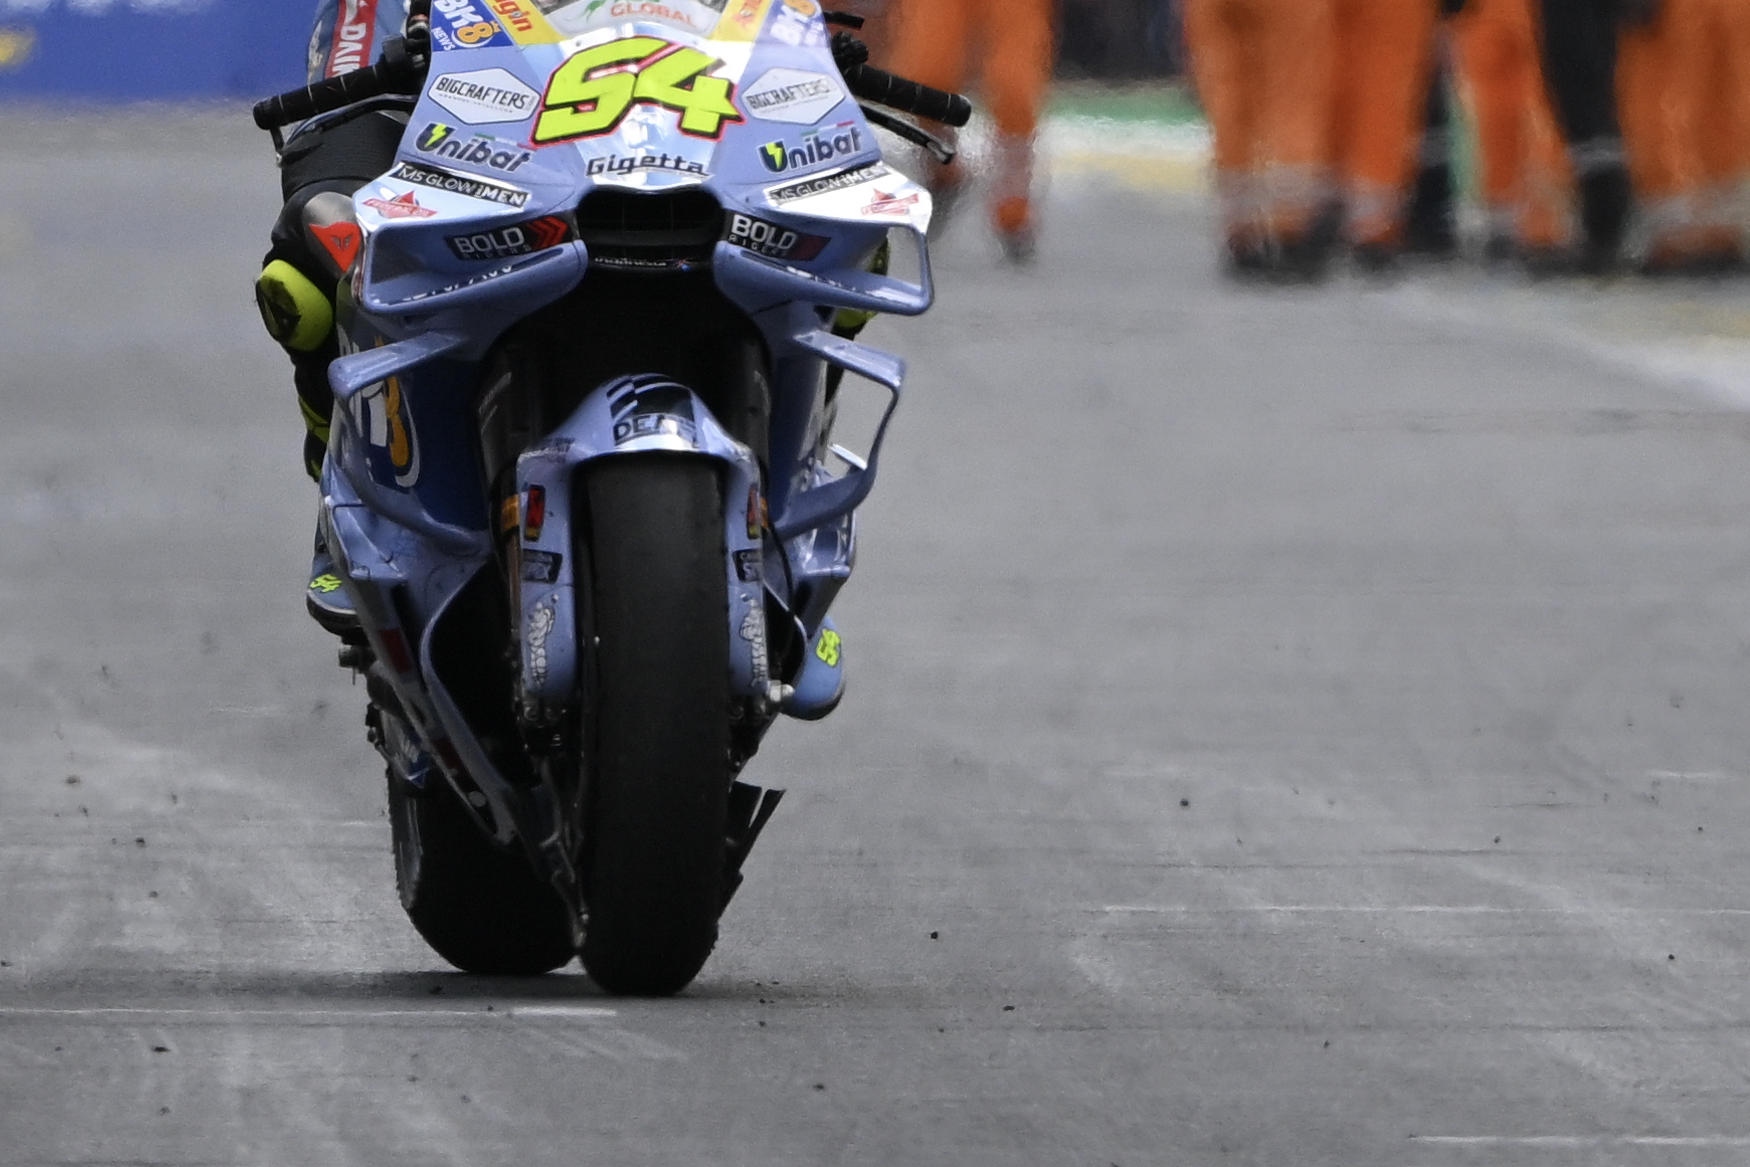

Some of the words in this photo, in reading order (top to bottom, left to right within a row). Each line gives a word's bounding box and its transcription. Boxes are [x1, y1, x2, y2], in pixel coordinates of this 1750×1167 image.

[610, 3, 697, 28] GLOBAL
[431, 26, 456, 52] NEWS
[435, 76, 530, 110] BIGCRAFTERS
[532, 35, 745, 145] 54
[746, 78, 831, 110] BIGCRAFTERS
[415, 123, 531, 173] Unibat
[758, 126, 862, 173] Unibat
[586, 152, 711, 178] Gigetta
[399, 166, 427, 184] MS
[426, 170, 478, 195] GLOW
[482, 186, 526, 206] MEN
[772, 188, 796, 202] MS
[796, 177, 841, 197] GLOW
[454, 226, 525, 255] BOLD
[731, 213, 798, 250] BOLD
[309, 573, 343, 594] 54
